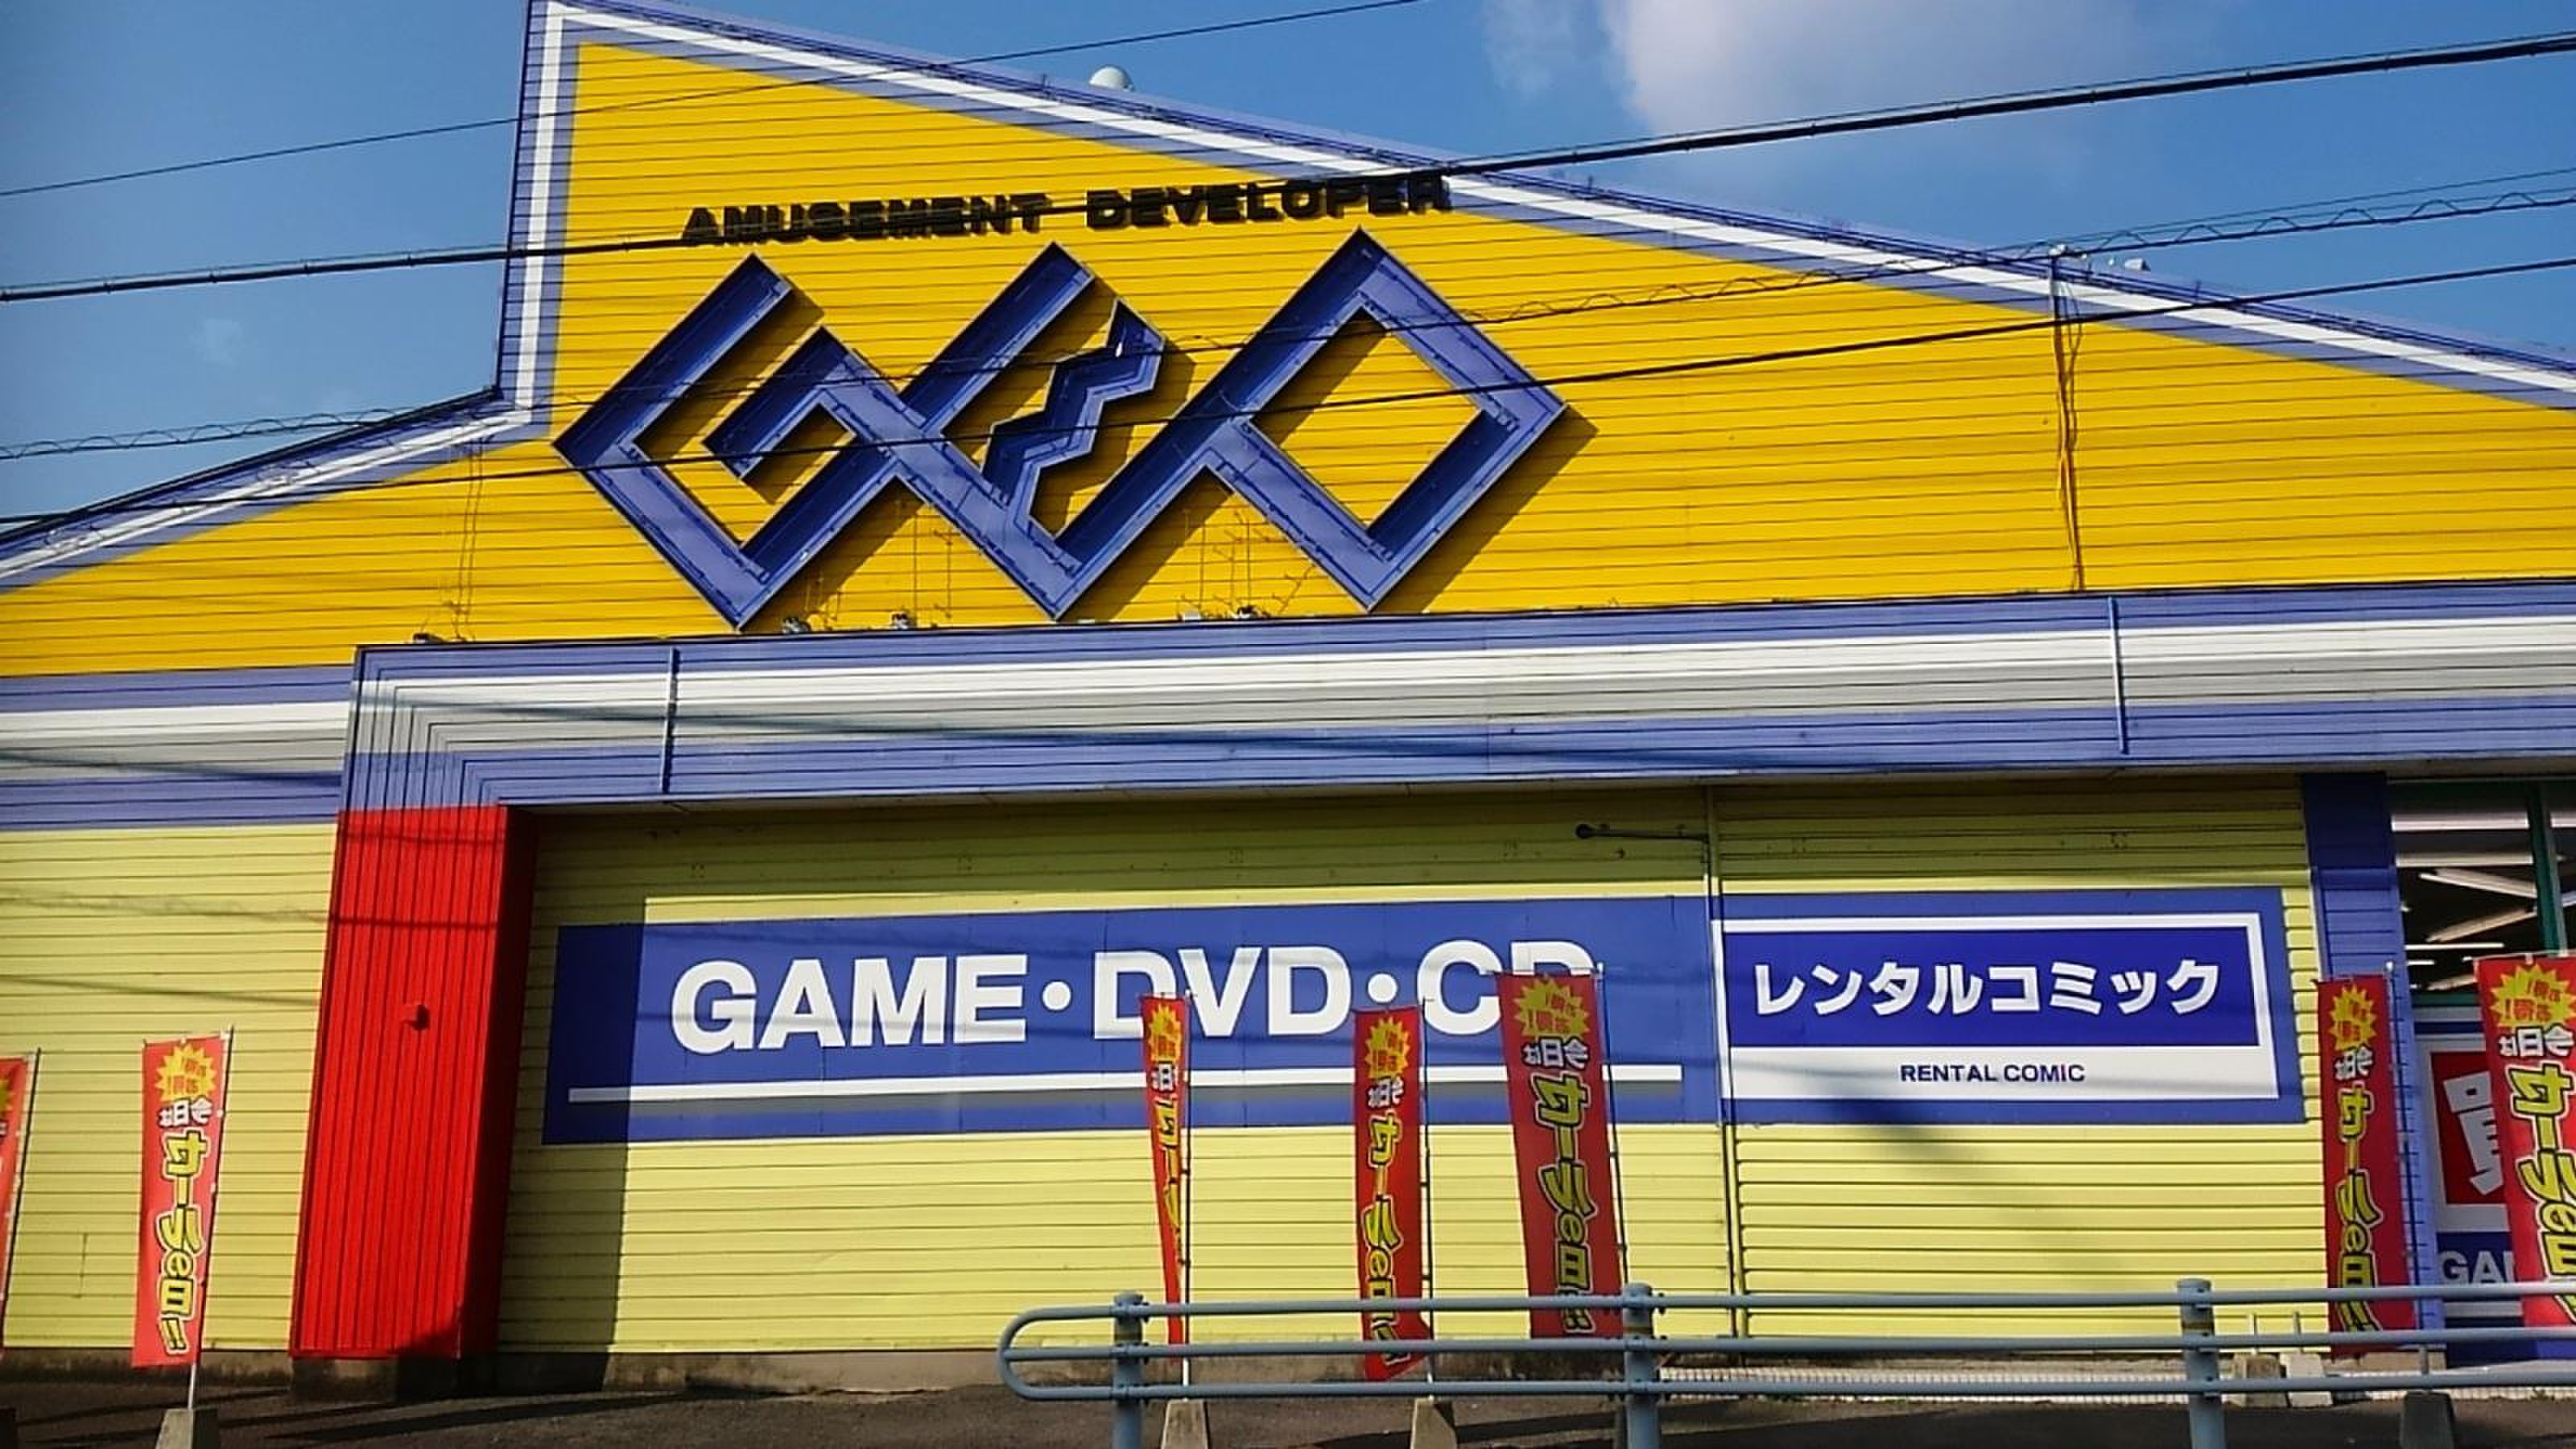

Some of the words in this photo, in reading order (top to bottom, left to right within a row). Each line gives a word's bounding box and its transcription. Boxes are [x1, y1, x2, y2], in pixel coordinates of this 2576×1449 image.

[681, 192, 1053, 243] AMUSEMENT
[1087, 173, 1447, 229] DEVELOPER
[1753, 960, 2219, 1016] レンタルコミック
[1901, 1063, 1997, 1084] RENTAL
[2004, 1063, 2086, 1083] COMIC
